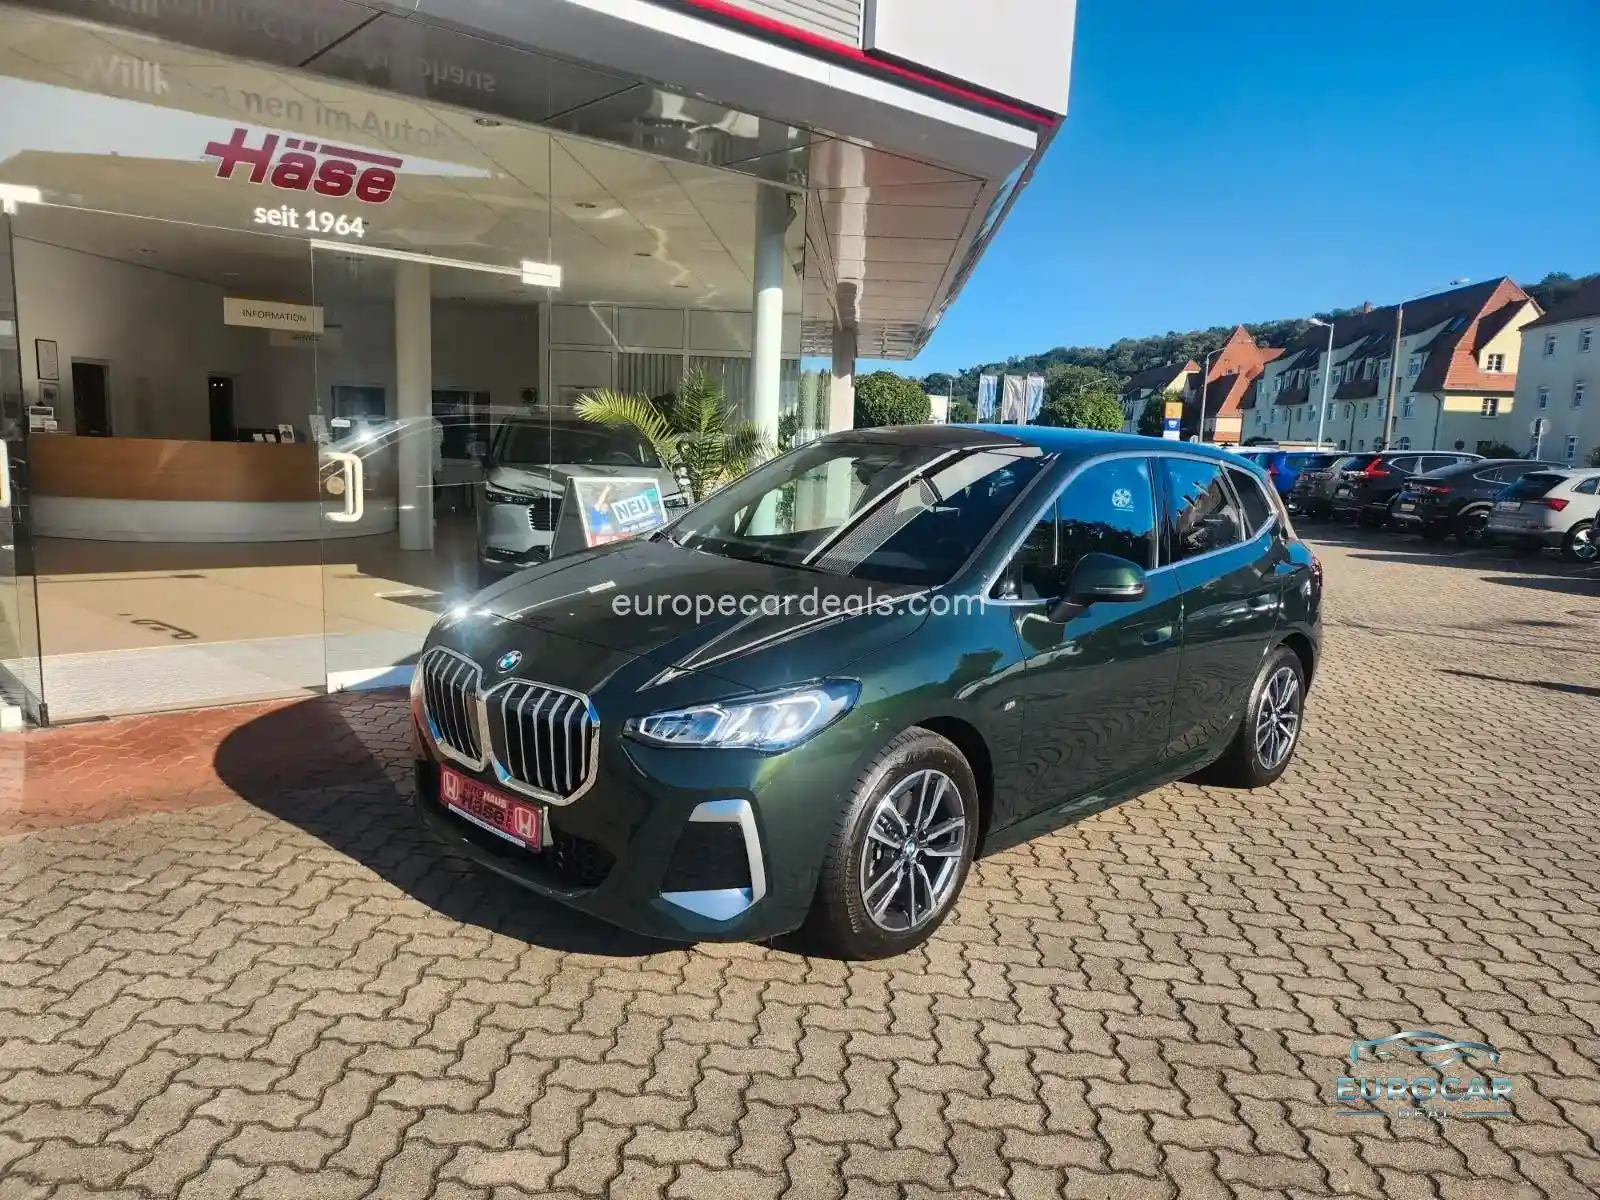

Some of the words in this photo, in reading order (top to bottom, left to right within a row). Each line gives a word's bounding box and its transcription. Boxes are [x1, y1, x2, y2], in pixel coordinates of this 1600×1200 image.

[204, 127, 403, 205] Häse
[253, 205, 300, 230] seit
[305, 208, 366, 239] 1964
[242, 309, 308, 323] INFORMATION
[614, 496, 651, 521] NEU
